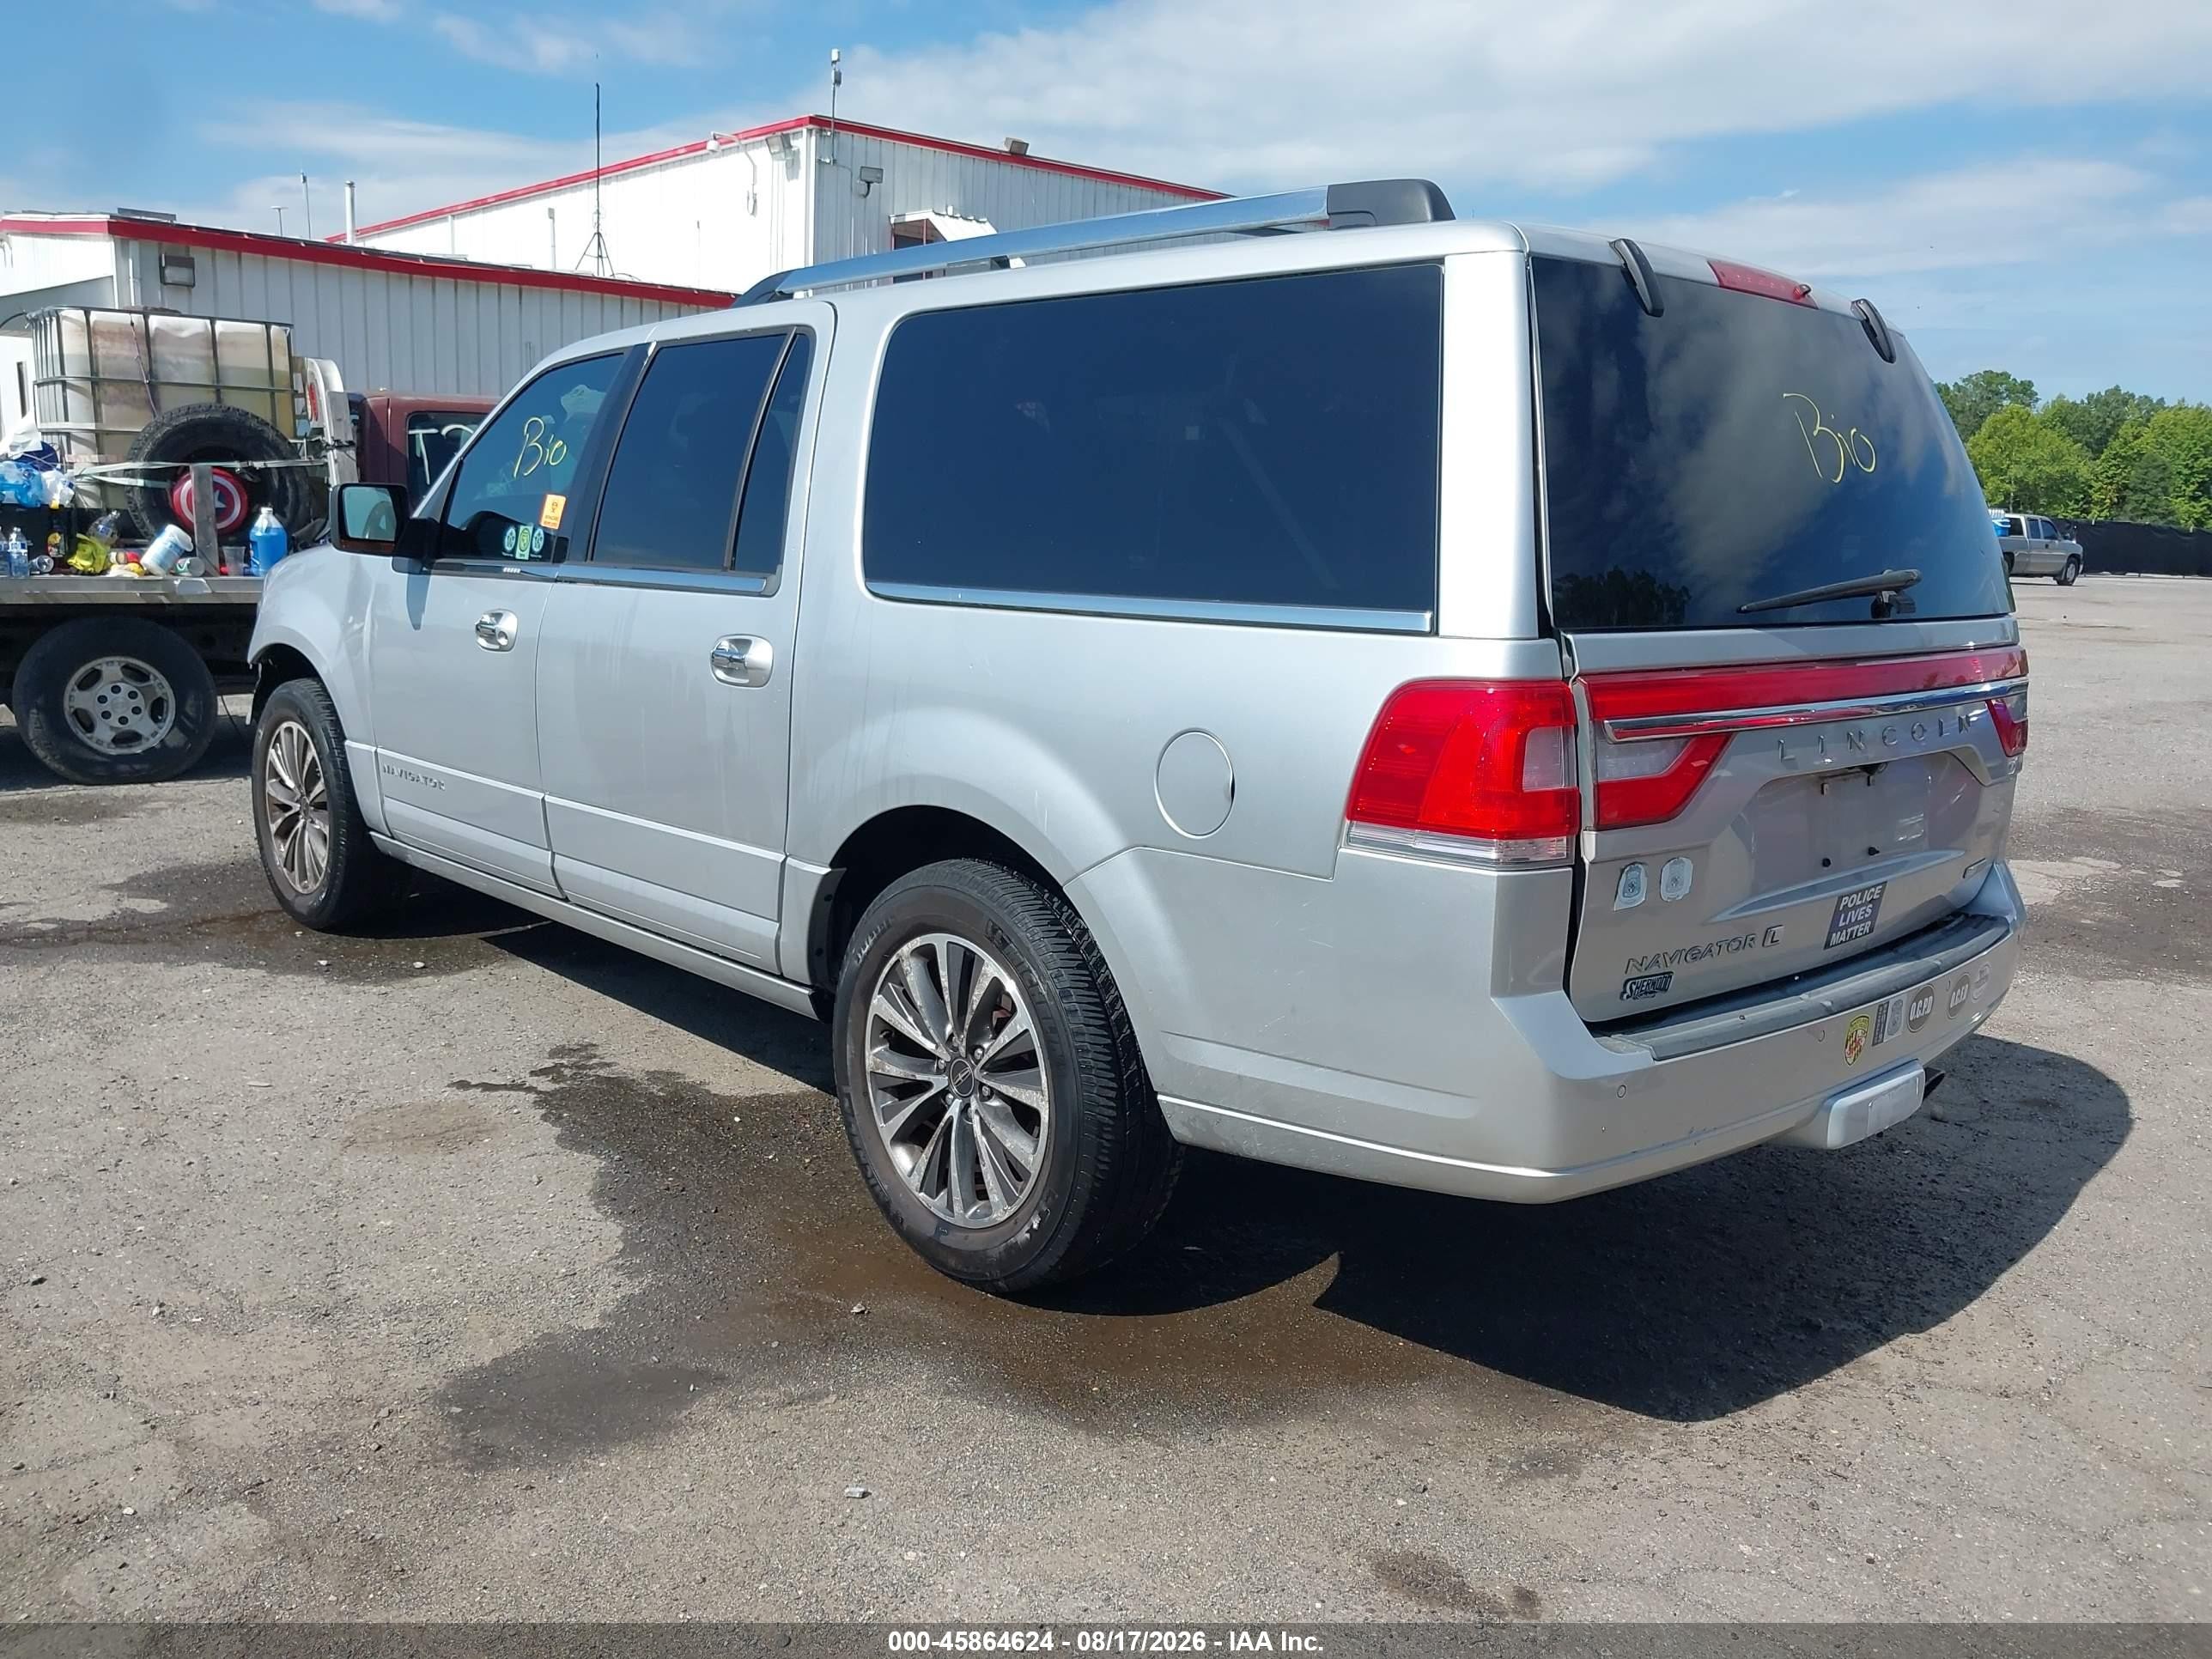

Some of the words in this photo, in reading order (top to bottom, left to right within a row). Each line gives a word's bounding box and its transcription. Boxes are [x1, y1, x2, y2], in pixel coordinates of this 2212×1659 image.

[514, 416, 567, 478] Bio
[1782, 392, 1876, 483] Bio
[1778, 714, 1972, 763] LINCOLN
[1838, 904, 1873, 927] LIVES
[1839, 885, 1883, 910] POLICE
[1625, 933, 1756, 974] NAVIGATOR
[1829, 921, 1872, 947] MATTER
